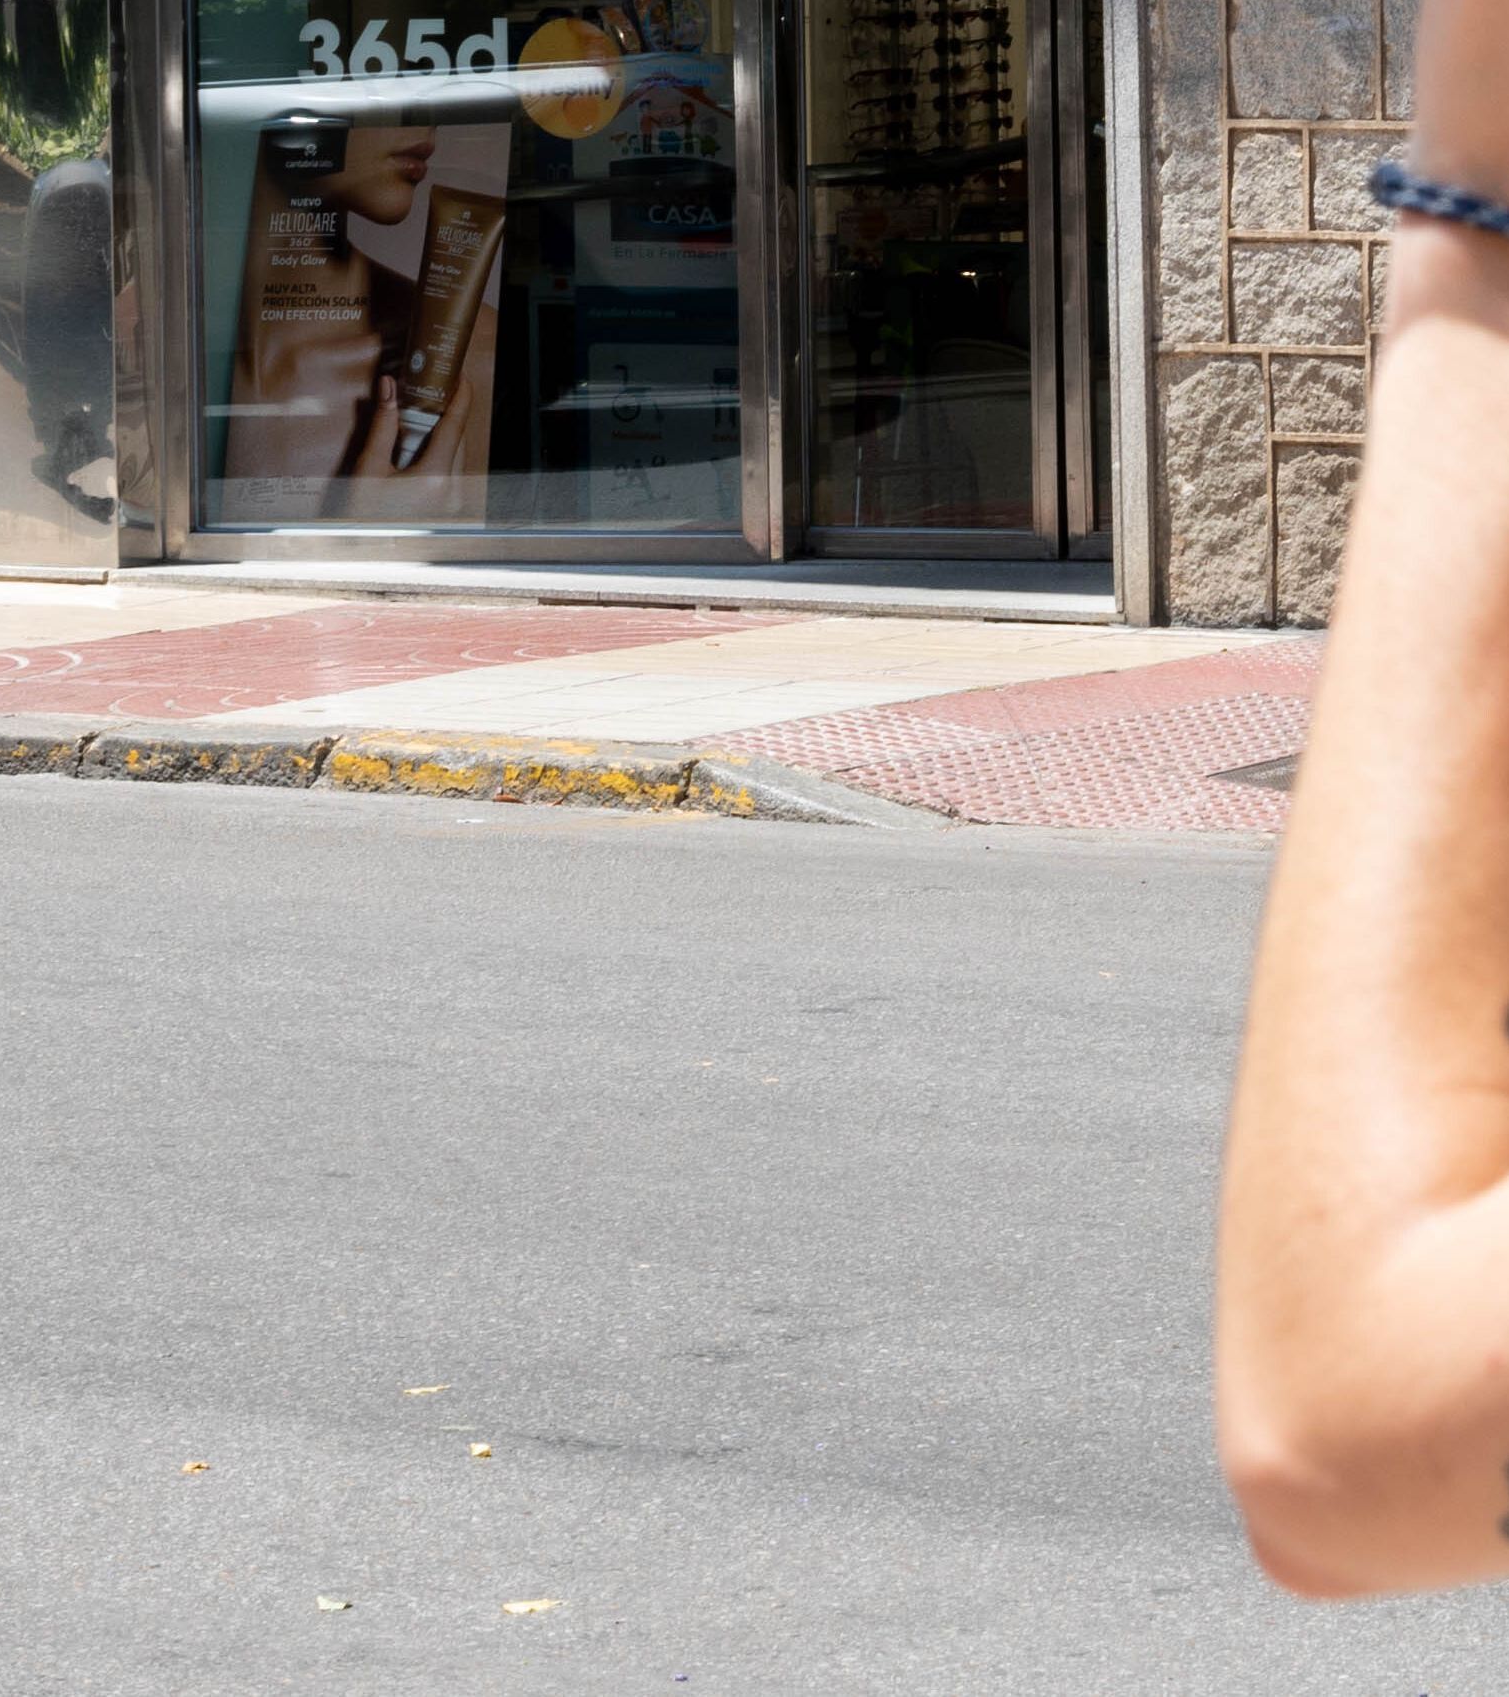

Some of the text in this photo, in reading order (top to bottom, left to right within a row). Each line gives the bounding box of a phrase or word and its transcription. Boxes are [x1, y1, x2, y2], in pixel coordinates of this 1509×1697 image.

[297, 17, 509, 83] 365d
[290, 198, 322, 207] NUEVO
[648, 205, 716, 224] CASA
[269, 212, 339, 233] HELIOCARE
[272, 255, 326, 267] Body Glow
[264, 284, 317, 294] MUY ALTA
[333, 296, 369, 307] SOLAR
[261, 310, 362, 321] CON EFECTO GLOW
